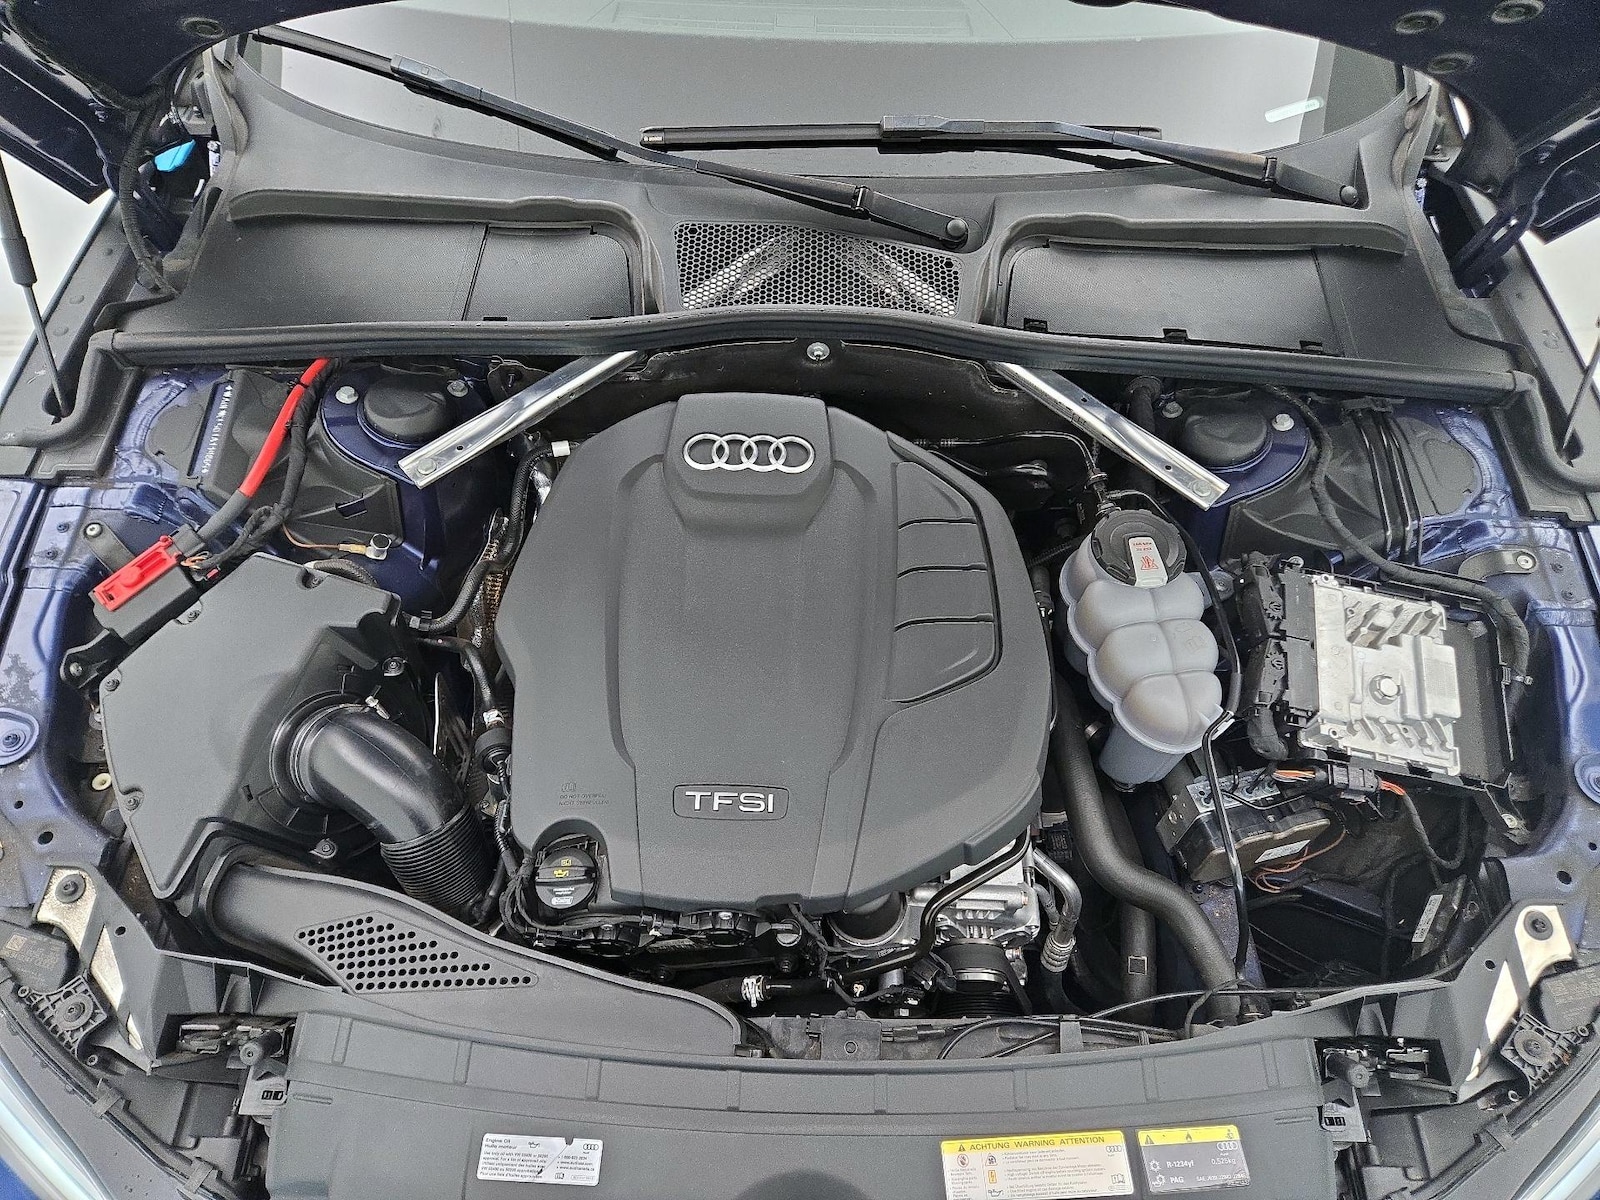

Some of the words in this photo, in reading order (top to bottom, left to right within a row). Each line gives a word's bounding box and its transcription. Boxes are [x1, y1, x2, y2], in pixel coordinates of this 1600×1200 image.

[685, 791, 774, 813] TFSI
[970, 1142, 1010, 1152] ACHTUNG
[1015, 1139, 1056, 1148] WARNING
[1060, 1136, 1105, 1145] ATTENTION
[1166, 1159, 1194, 1169] R-1234yf
[1170, 1176, 1184, 1184] PAG
